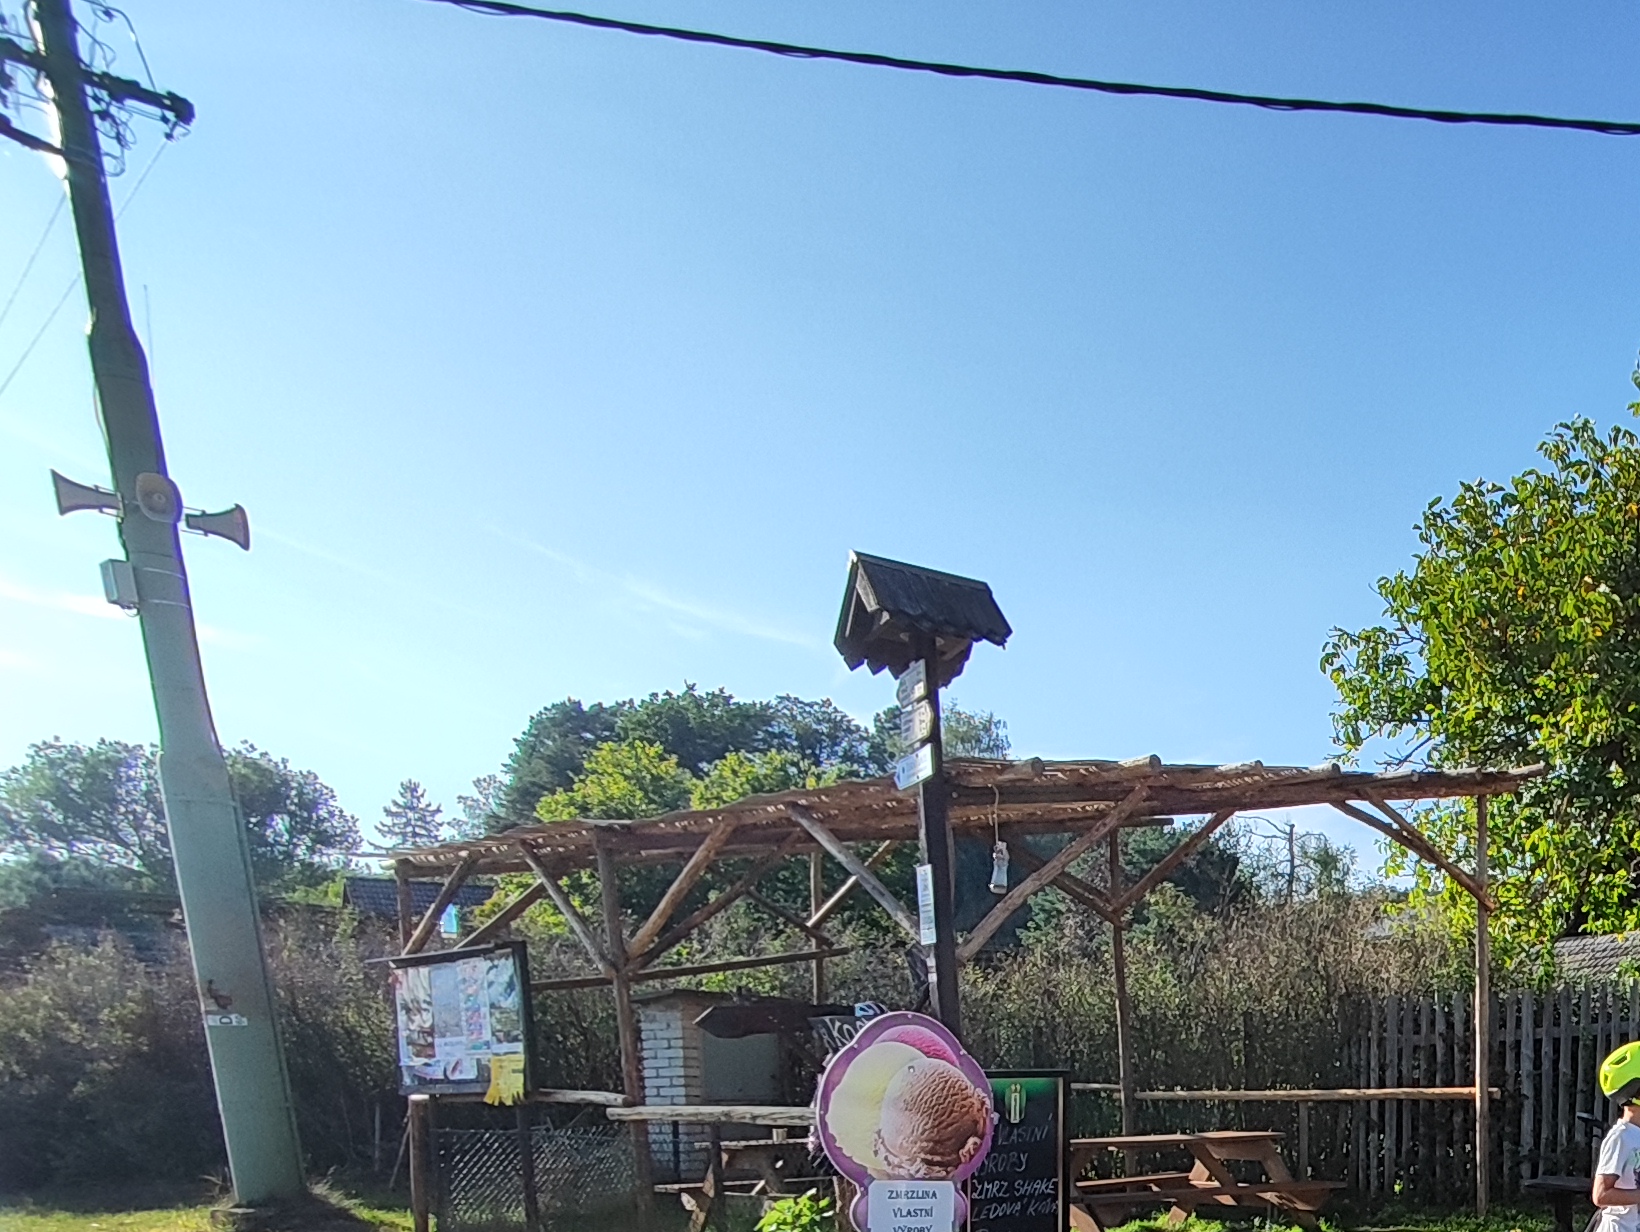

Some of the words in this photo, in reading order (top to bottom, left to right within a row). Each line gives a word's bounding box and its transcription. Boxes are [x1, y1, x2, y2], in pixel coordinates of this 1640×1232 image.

[974, 1151, 1029, 1177] ROBY
[887, 1190, 938, 1200] ZMRZLINA
[971, 1179, 1010, 1200] ZMRZ
[1014, 1178, 1058, 1197] SHAKE
[892, 1206, 934, 1218] VLASTNÍ
